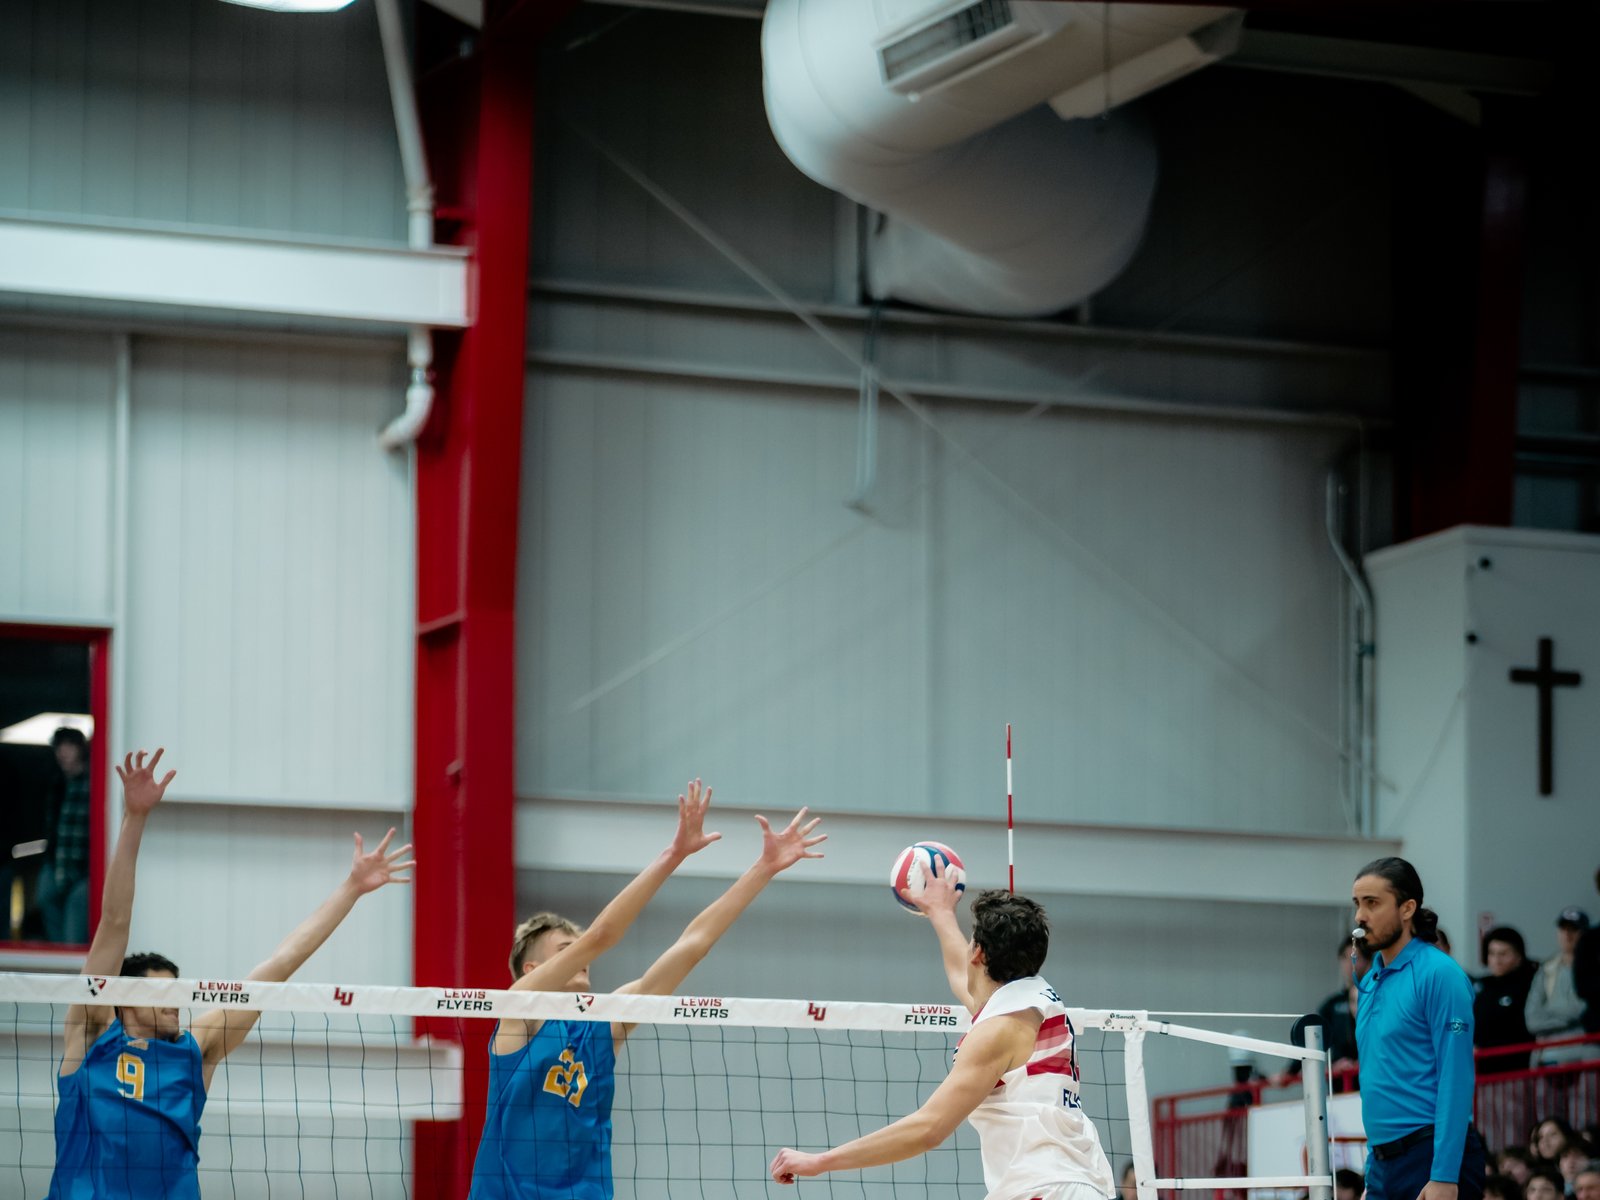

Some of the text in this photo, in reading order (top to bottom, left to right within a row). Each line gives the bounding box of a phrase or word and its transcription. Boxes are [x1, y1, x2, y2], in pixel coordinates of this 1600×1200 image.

[199, 981, 243, 992] LEWIS
[192, 991, 250, 1004] FLYERS
[333, 987, 354, 1006] LU
[444, 990, 486, 1000] LEWIS
[437, 1000, 493, 1012] FLYERS
[681, 998, 722, 1007] LEWIS
[674, 1007, 729, 1019] FLYERS
[807, 1002, 827, 1022] LU
[911, 1005, 952, 1015] LEWIS
[904, 1015, 958, 1026] FLYERS
[116, 1052, 145, 1102] 9
